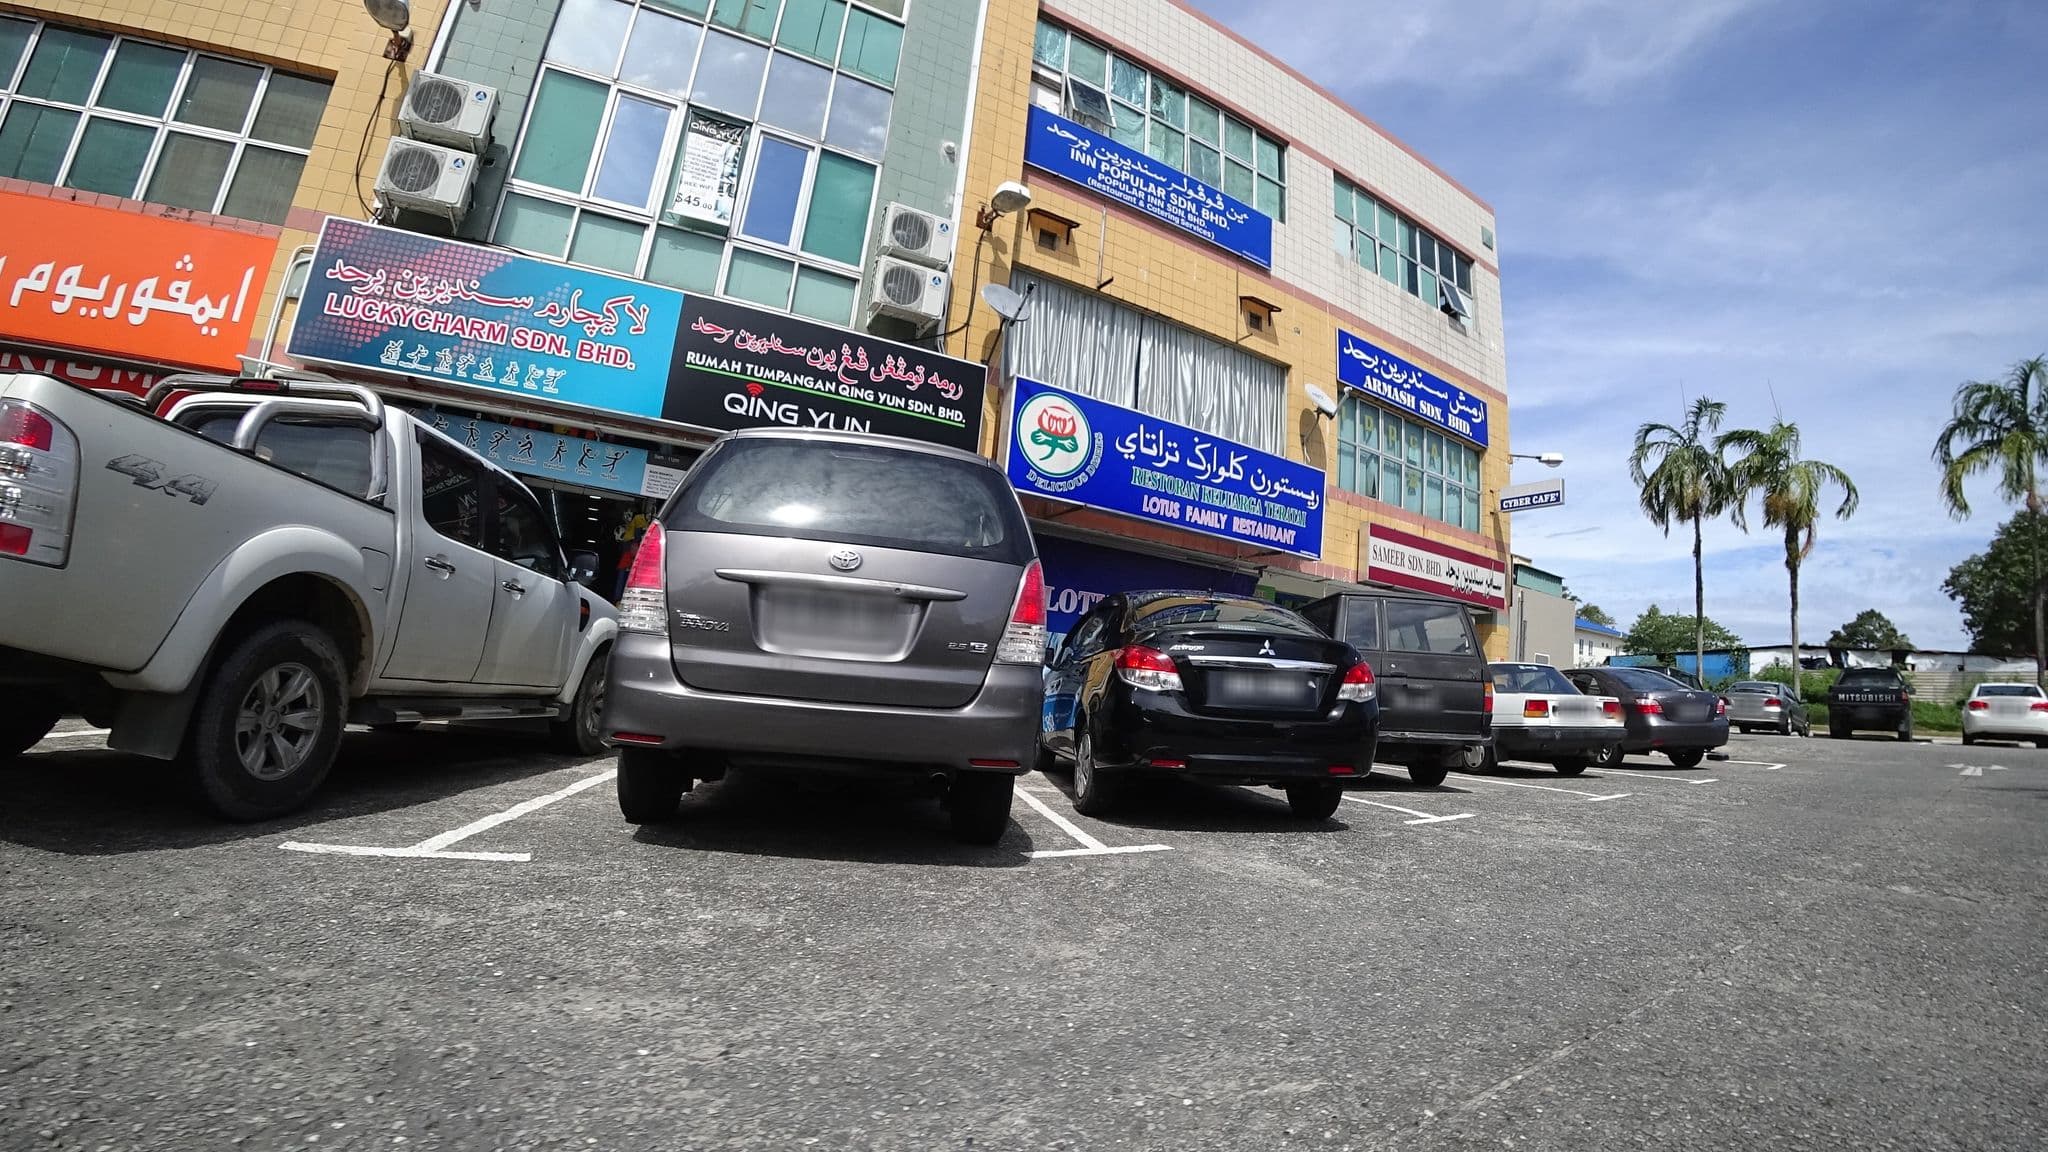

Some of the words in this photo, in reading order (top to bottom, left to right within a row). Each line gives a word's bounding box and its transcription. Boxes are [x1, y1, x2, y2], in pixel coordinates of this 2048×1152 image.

[690, 121, 718, 135] QING
[1046, 122, 1091, 152] برحد
[1094, 147, 1168, 183] سنديرين
[1070, 147, 1097, 170] INN
[1100, 159, 1167, 201] POPULAR
[1169, 191, 1199, 215] SDN.
[1200, 206, 1231, 231] BHD.
[1087, 176, 1138, 206] (Restaurant
[1138, 200, 1145, 209] &
[1146, 204, 1180, 225] Catering
[1180, 216, 1215, 241] Services)
[1098, 173, 1146, 202] POPULAR
[1147, 194, 1166, 209] INN
[1166, 202, 1187, 219] SDN.
[1187, 213, 1208, 229] BHD.
[10, 254, 256, 337] ايمڤوريوم
[325, 258, 387, 297] برحد
[393, 269, 536, 311] سنديرين
[324, 292, 510, 345] LUCKYCHARM
[511, 326, 571, 358] SDN.
[577, 343, 636, 371] BHD.
[734, 332, 807, 358] سنديرين
[1343, 337, 1380, 370] برحد
[686, 350, 743, 375] RUMAH
[745, 362, 837, 393] TUMPANGAN
[837, 382, 875, 402] QING
[877, 391, 907, 409] YUN
[907, 398, 936, 417] SDN.
[938, 406, 967, 424] BHD.
[1380, 359, 1448, 400] سنديرين
[807, 407, 872, 433] YUN
[1363, 375, 1417, 412] ARMASH
[1419, 399, 1445, 423] SDN.
[1448, 415, 1474, 438] BHD.
[1448, 391, 1485, 424] ارمش
[1115, 424, 1181, 468] تراتاي
[1026, 468, 1089, 492] DELICIOUS
[1131, 466, 1201, 500] RESTORAN
[1202, 484, 1264, 515] KELUARGA
[1264, 501, 1307, 528] TERATAI
[1250, 466, 1320, 510] ريستورن
[1142, 494, 1181, 519] LOTUS
[1186, 505, 1228, 530] FAMILY
[1232, 516, 1297, 546] RESTAURANT
[1502, 496, 1531, 509] CYBER
[1372, 544, 1406, 569] SAMEER
[1407, 554, 1426, 573] SDN.
[1046, 585, 1107, 616] LOT
[1838, 693, 1896, 702] MITSUBISHI
